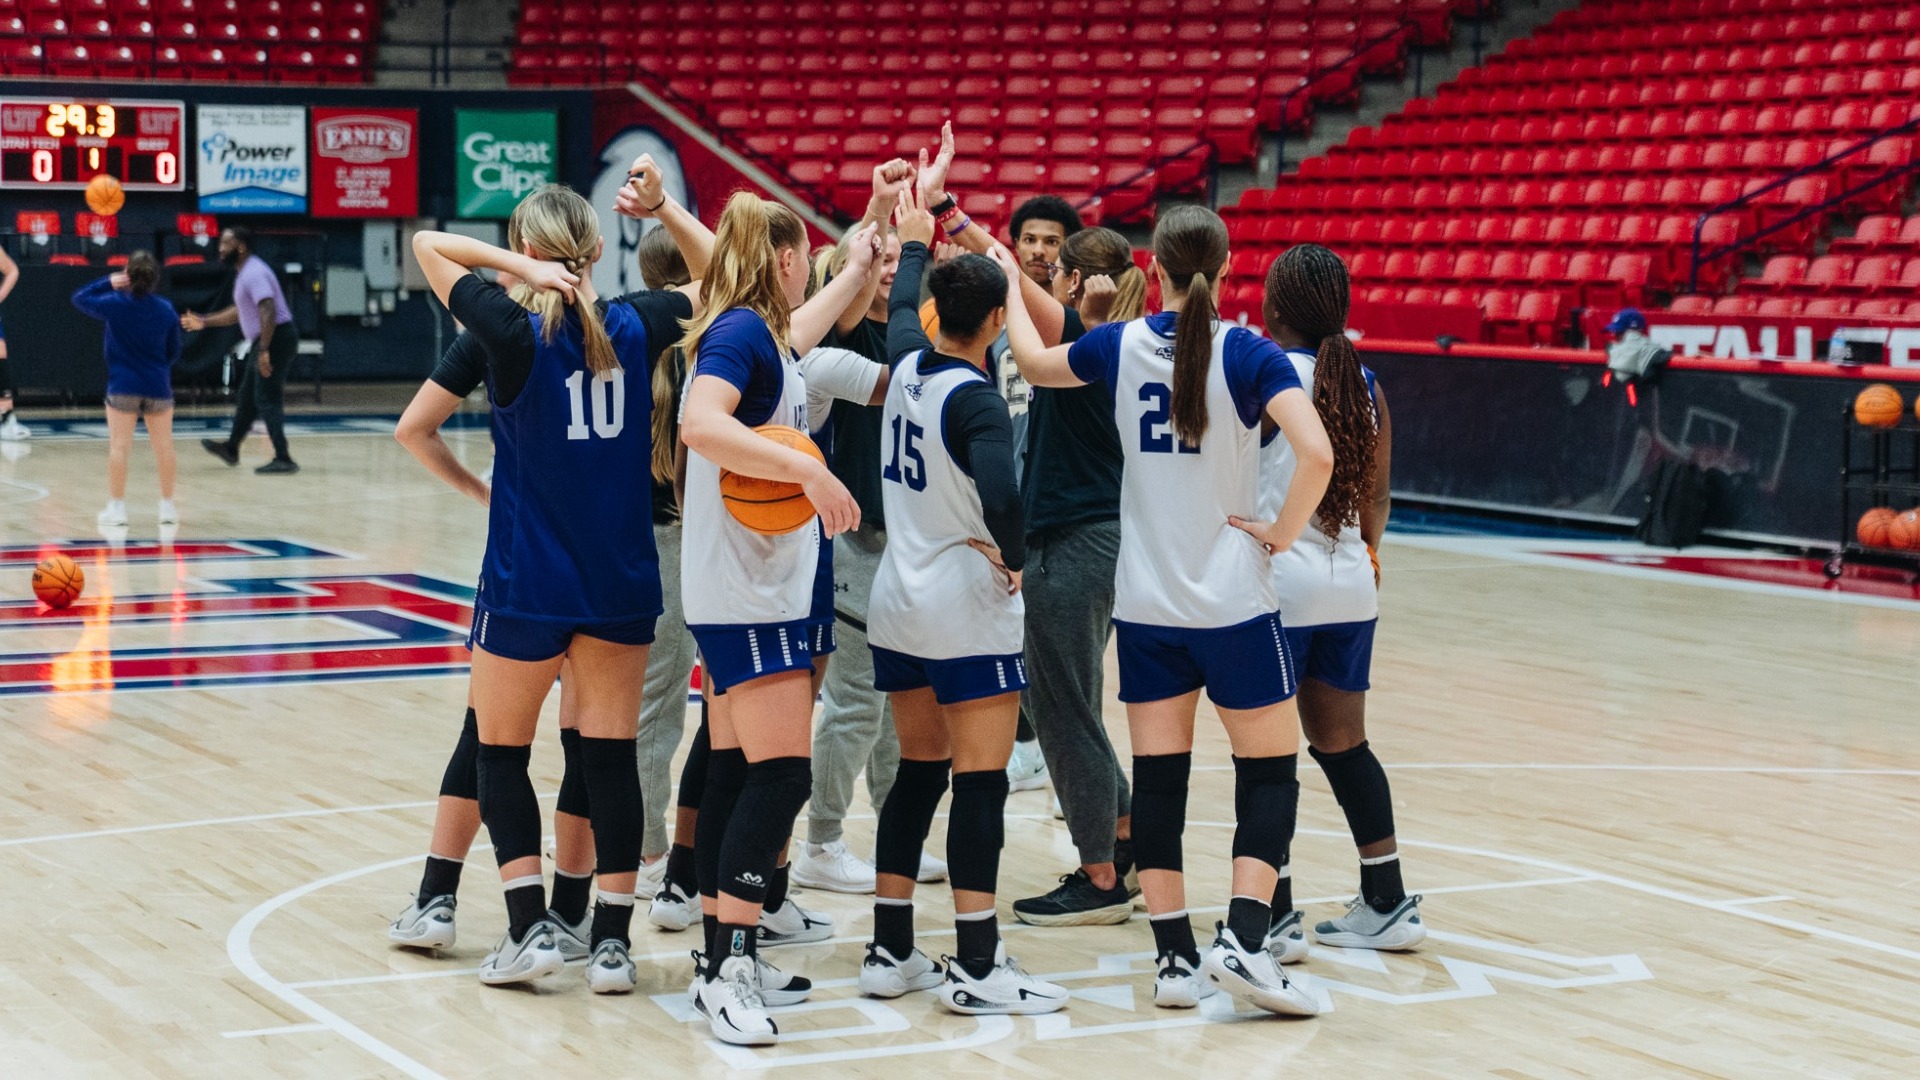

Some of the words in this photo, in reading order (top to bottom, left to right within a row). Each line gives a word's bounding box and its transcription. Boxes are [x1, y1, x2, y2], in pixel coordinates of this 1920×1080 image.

[46, 104, 116, 137] 29.3
[220, 138, 296, 165] Power
[326, 127, 403, 151] ERNIE'S
[464, 132, 551, 165] Great
[32, 150, 53, 182] 0
[89, 147, 99, 170] 1
[156, 152, 176, 184] 0
[224, 164, 301, 186] Image
[472, 163, 549, 199] Clips
[565, 368, 626, 441] 10
[1138, 381, 1202, 454] 2
[882, 414, 927, 493] 15
